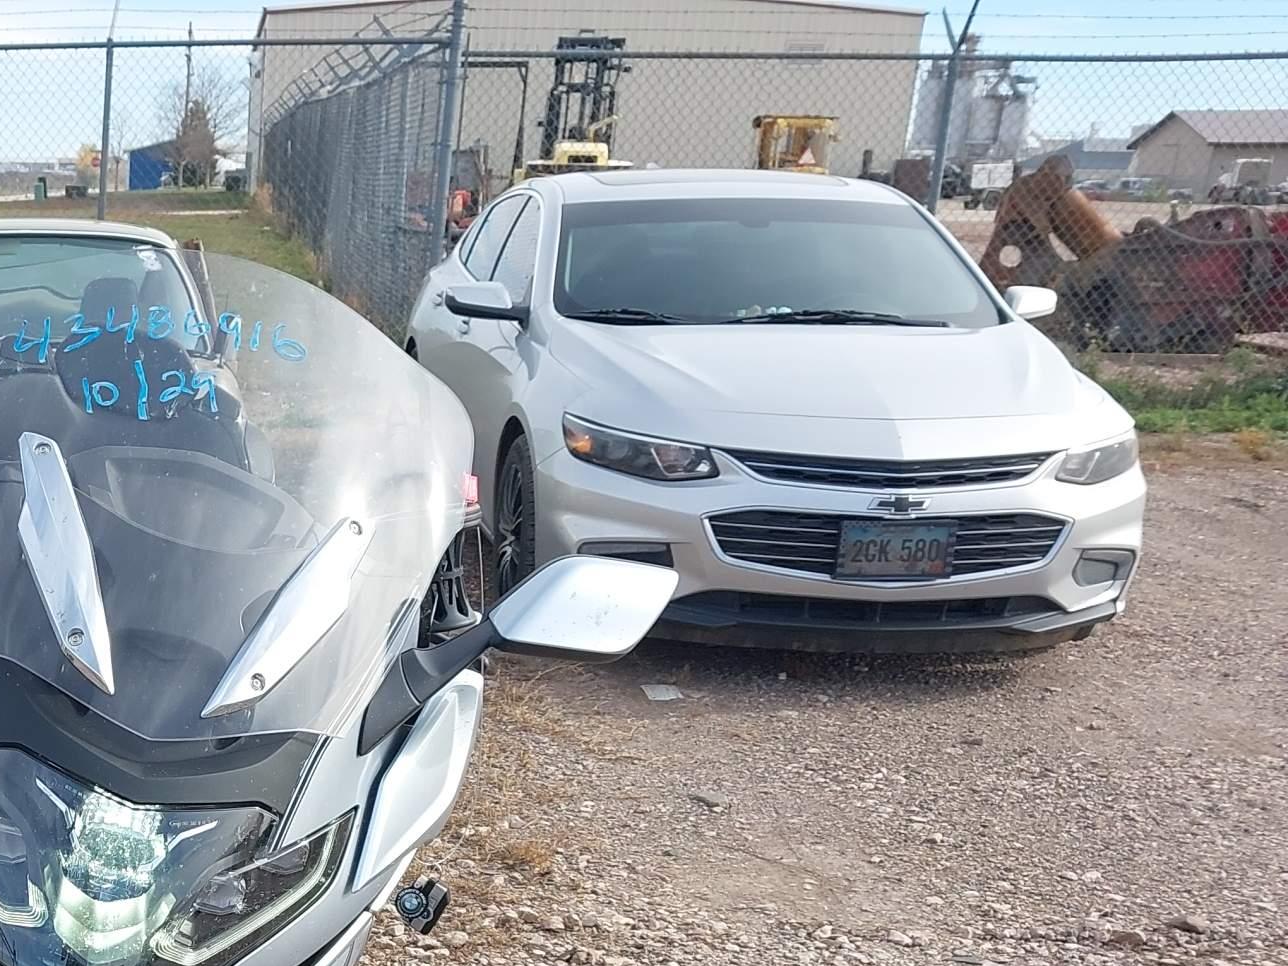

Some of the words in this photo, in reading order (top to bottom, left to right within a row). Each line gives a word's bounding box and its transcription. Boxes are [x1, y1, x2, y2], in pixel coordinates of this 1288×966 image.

[13, 303, 307, 363] 43486916
[81, 358, 218, 421] 10/29
[899, 538, 941, 562] 580
